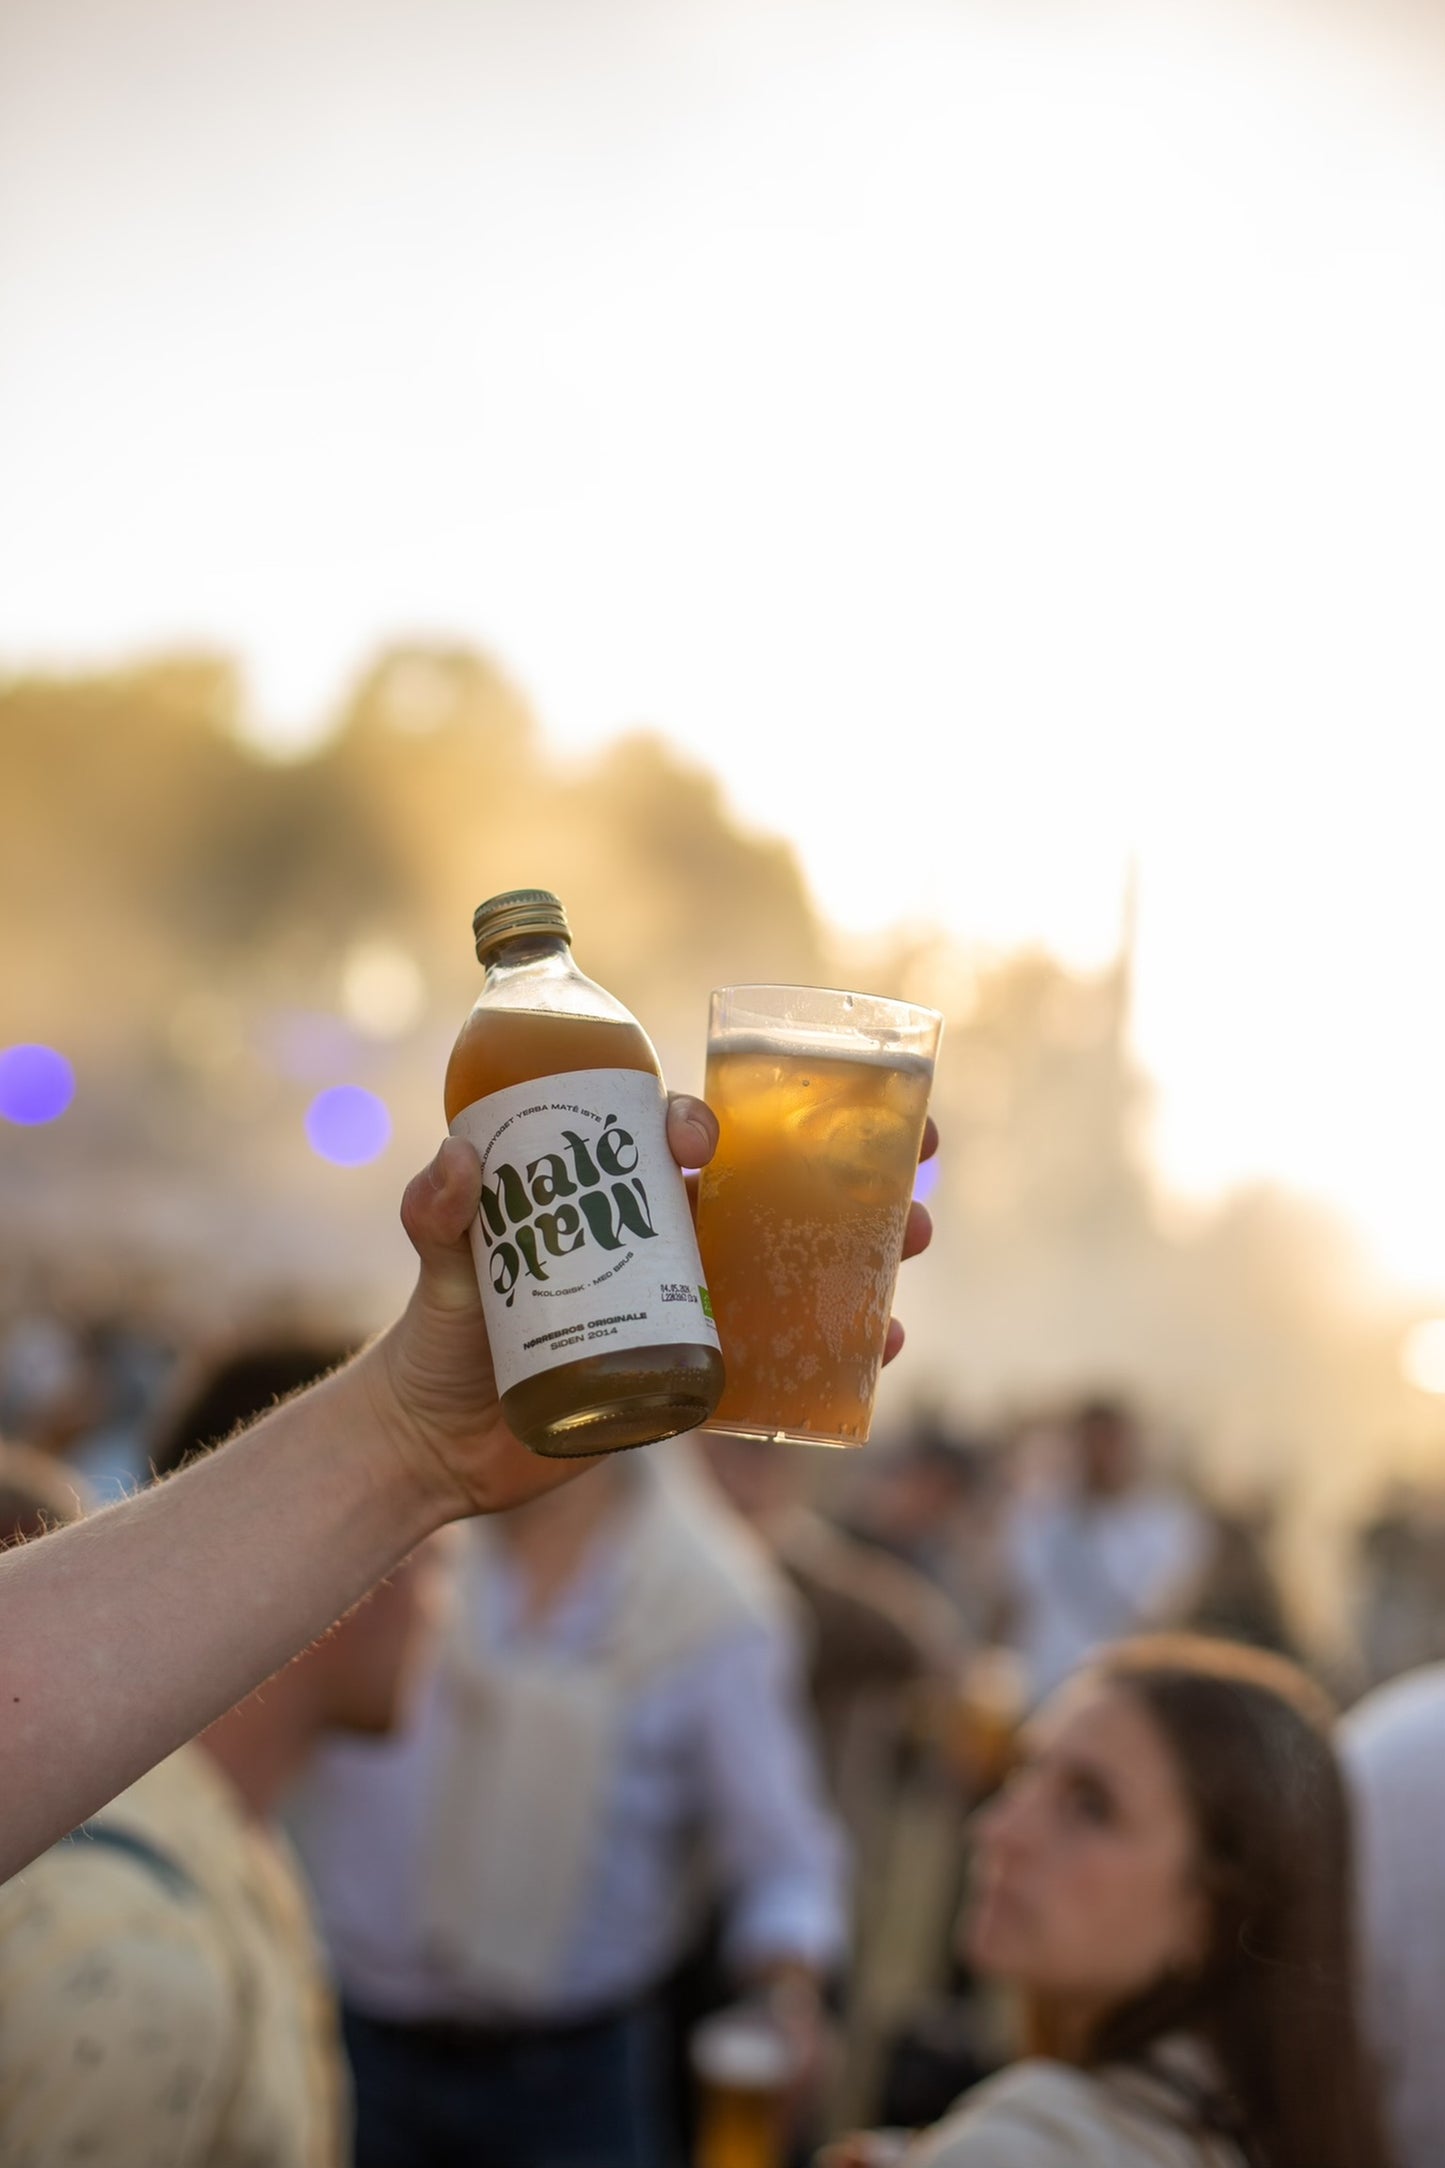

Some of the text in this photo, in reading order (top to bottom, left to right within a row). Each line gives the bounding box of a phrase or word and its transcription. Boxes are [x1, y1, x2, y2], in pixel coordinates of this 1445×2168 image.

[516, 1104, 549, 1119] YERBA
[551, 1103, 580, 1114] MATÉ
[580, 1109, 603, 1123] ISTE
[479, 1114, 639, 1247] Maté
[489, 1178, 660, 1308] Maté
[532, 1251, 635, 1297] ØKOLOGISK MED BRUS
[523, 1312, 648, 1351] NØRREBROS ORIGINALE
[550, 1327, 619, 1351] SIDEN 2014
